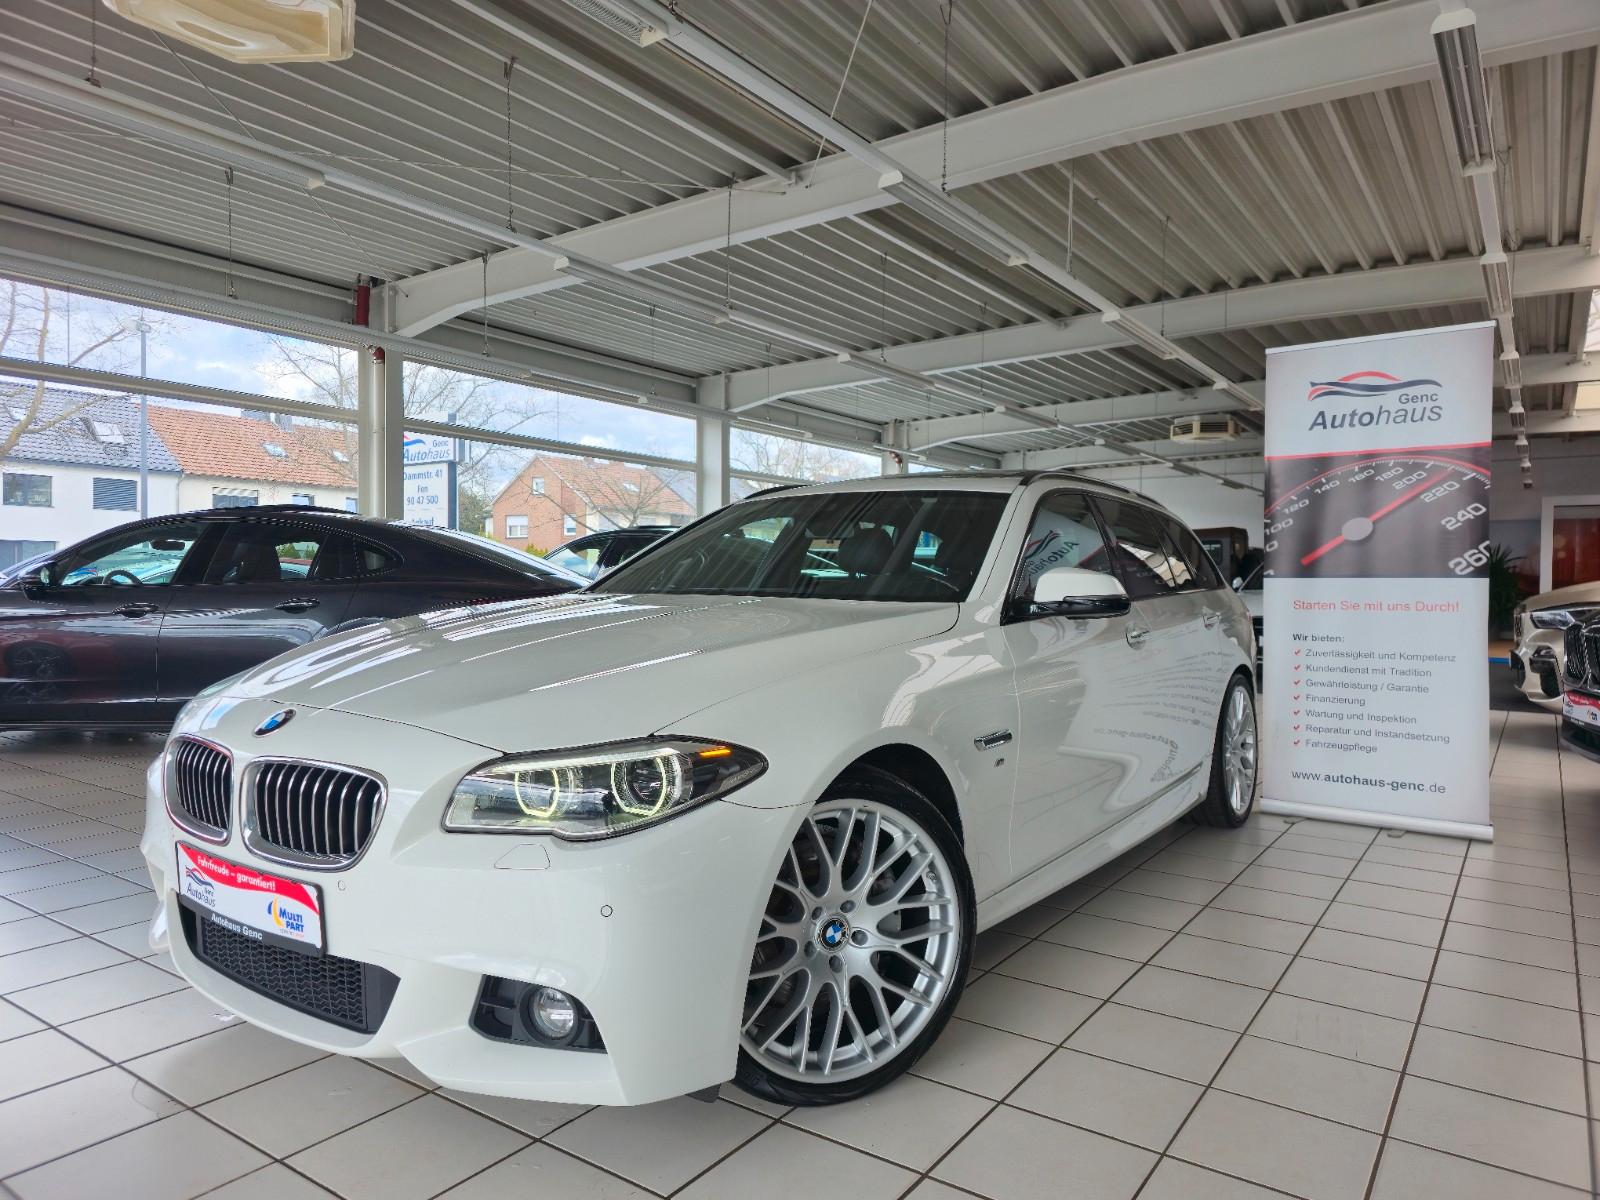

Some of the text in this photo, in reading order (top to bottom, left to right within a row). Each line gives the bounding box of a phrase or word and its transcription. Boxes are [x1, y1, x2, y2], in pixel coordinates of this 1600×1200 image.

[1398, 392, 1439, 405] Genc
[1308, 405, 1443, 431] Autohaus
[403, 448, 450, 461] Autohaus
[1348, 469, 1375, 483] 160
[1374, 467, 1404, 482] 180
[1392, 471, 1427, 490] 200
[1314, 479, 1340, 494] 140
[1420, 481, 1460, 503] 220
[426, 495, 439, 505] 500
[1440, 503, 1487, 530] 240
[1264, 518, 1294, 535] 100
[1293, 600, 1459, 612] Starten Sie mit uns Durch!
[1292, 633, 1344, 643] Wir bieten:
[1305, 649, 1456, 663] Zuverlässigkeit und Kompetenz
[1305, 664, 1432, 677] Kundendienst mit Tradition
[1305, 679, 1378, 692] Gewährleistung
[1387, 683, 1429, 693] Garantie
[1305, 694, 1366, 706] Finanzierung
[1305, 709, 1417, 724] Wartung und Inspektion
[1305, 724, 1450, 744] Reparatur und Instandsetzung
[1305, 739, 1378, 753] Fahrzeugpflege
[1291, 770, 1446, 794] www.autohaus-genc.de
[242, 925, 263, 940] Genc
[285, 920, 304, 932] PART
